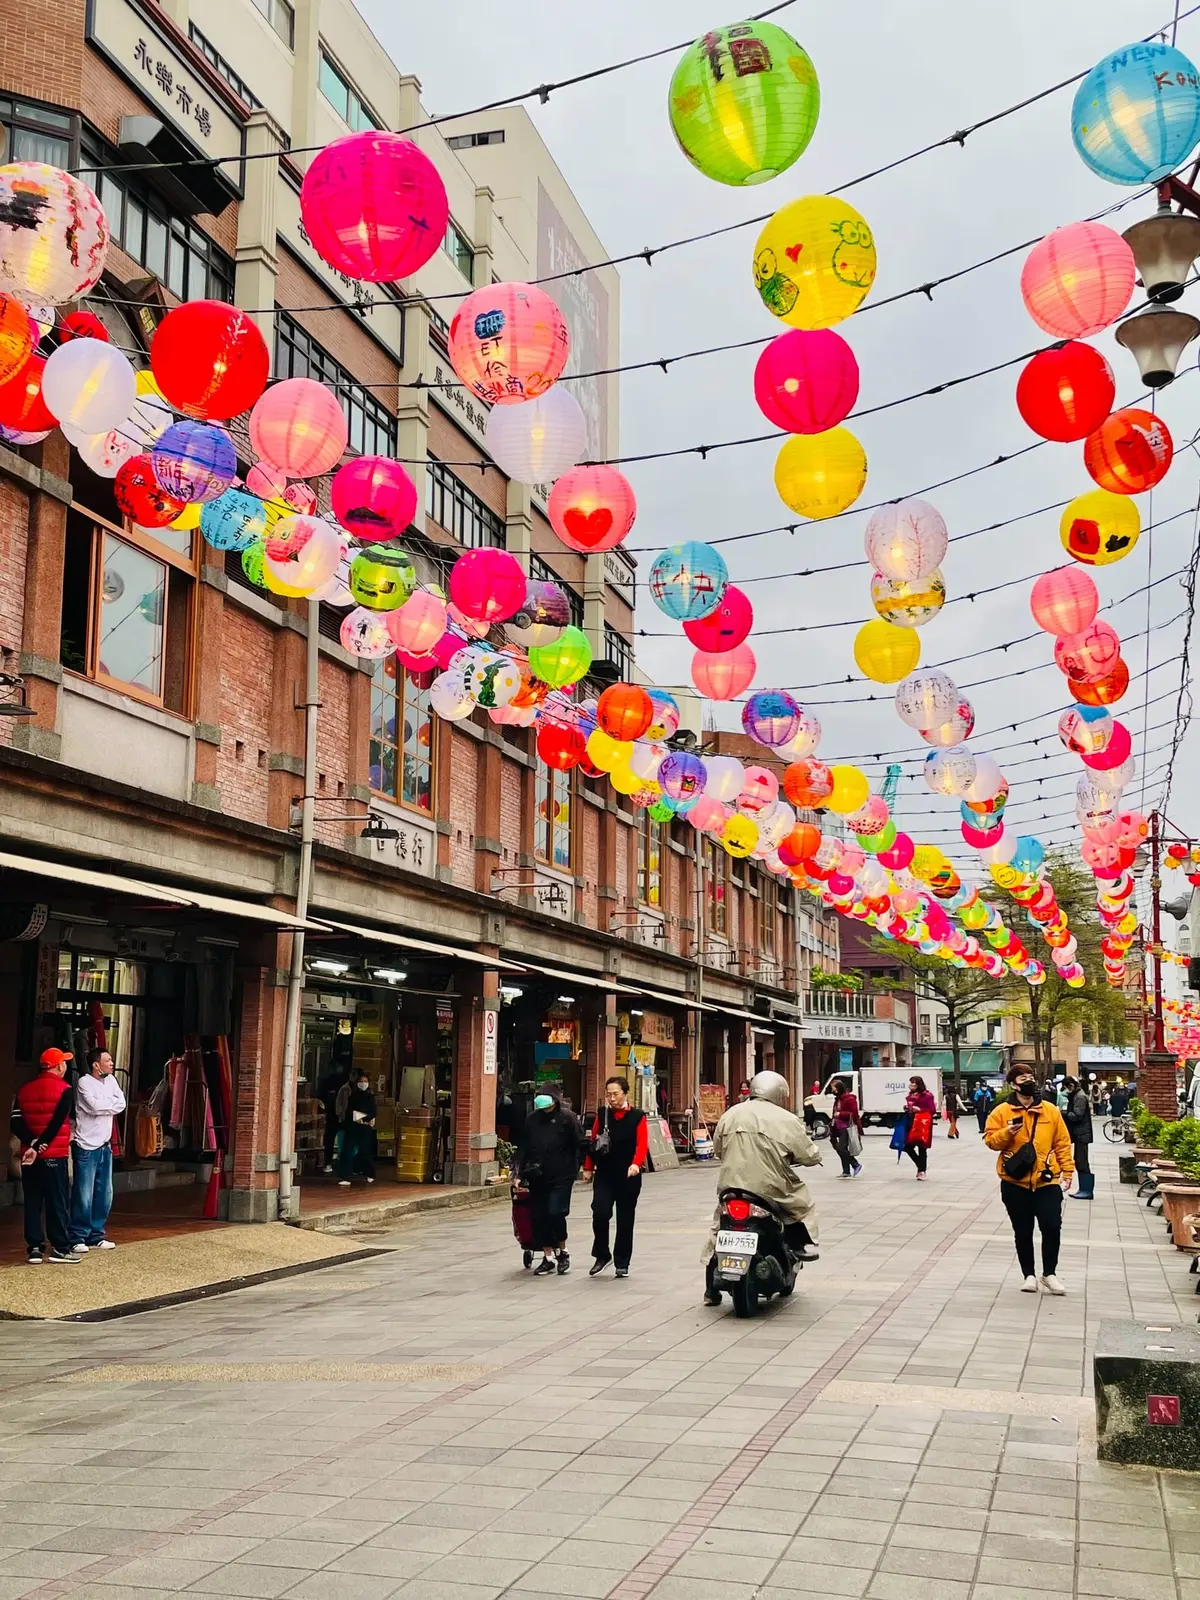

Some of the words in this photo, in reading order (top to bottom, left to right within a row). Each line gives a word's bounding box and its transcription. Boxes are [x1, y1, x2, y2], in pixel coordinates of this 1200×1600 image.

[1111, 46, 1166, 73] NEW
[133, 38, 211, 138] 永樂市場
[884, 1082, 906, 1092] aqua
